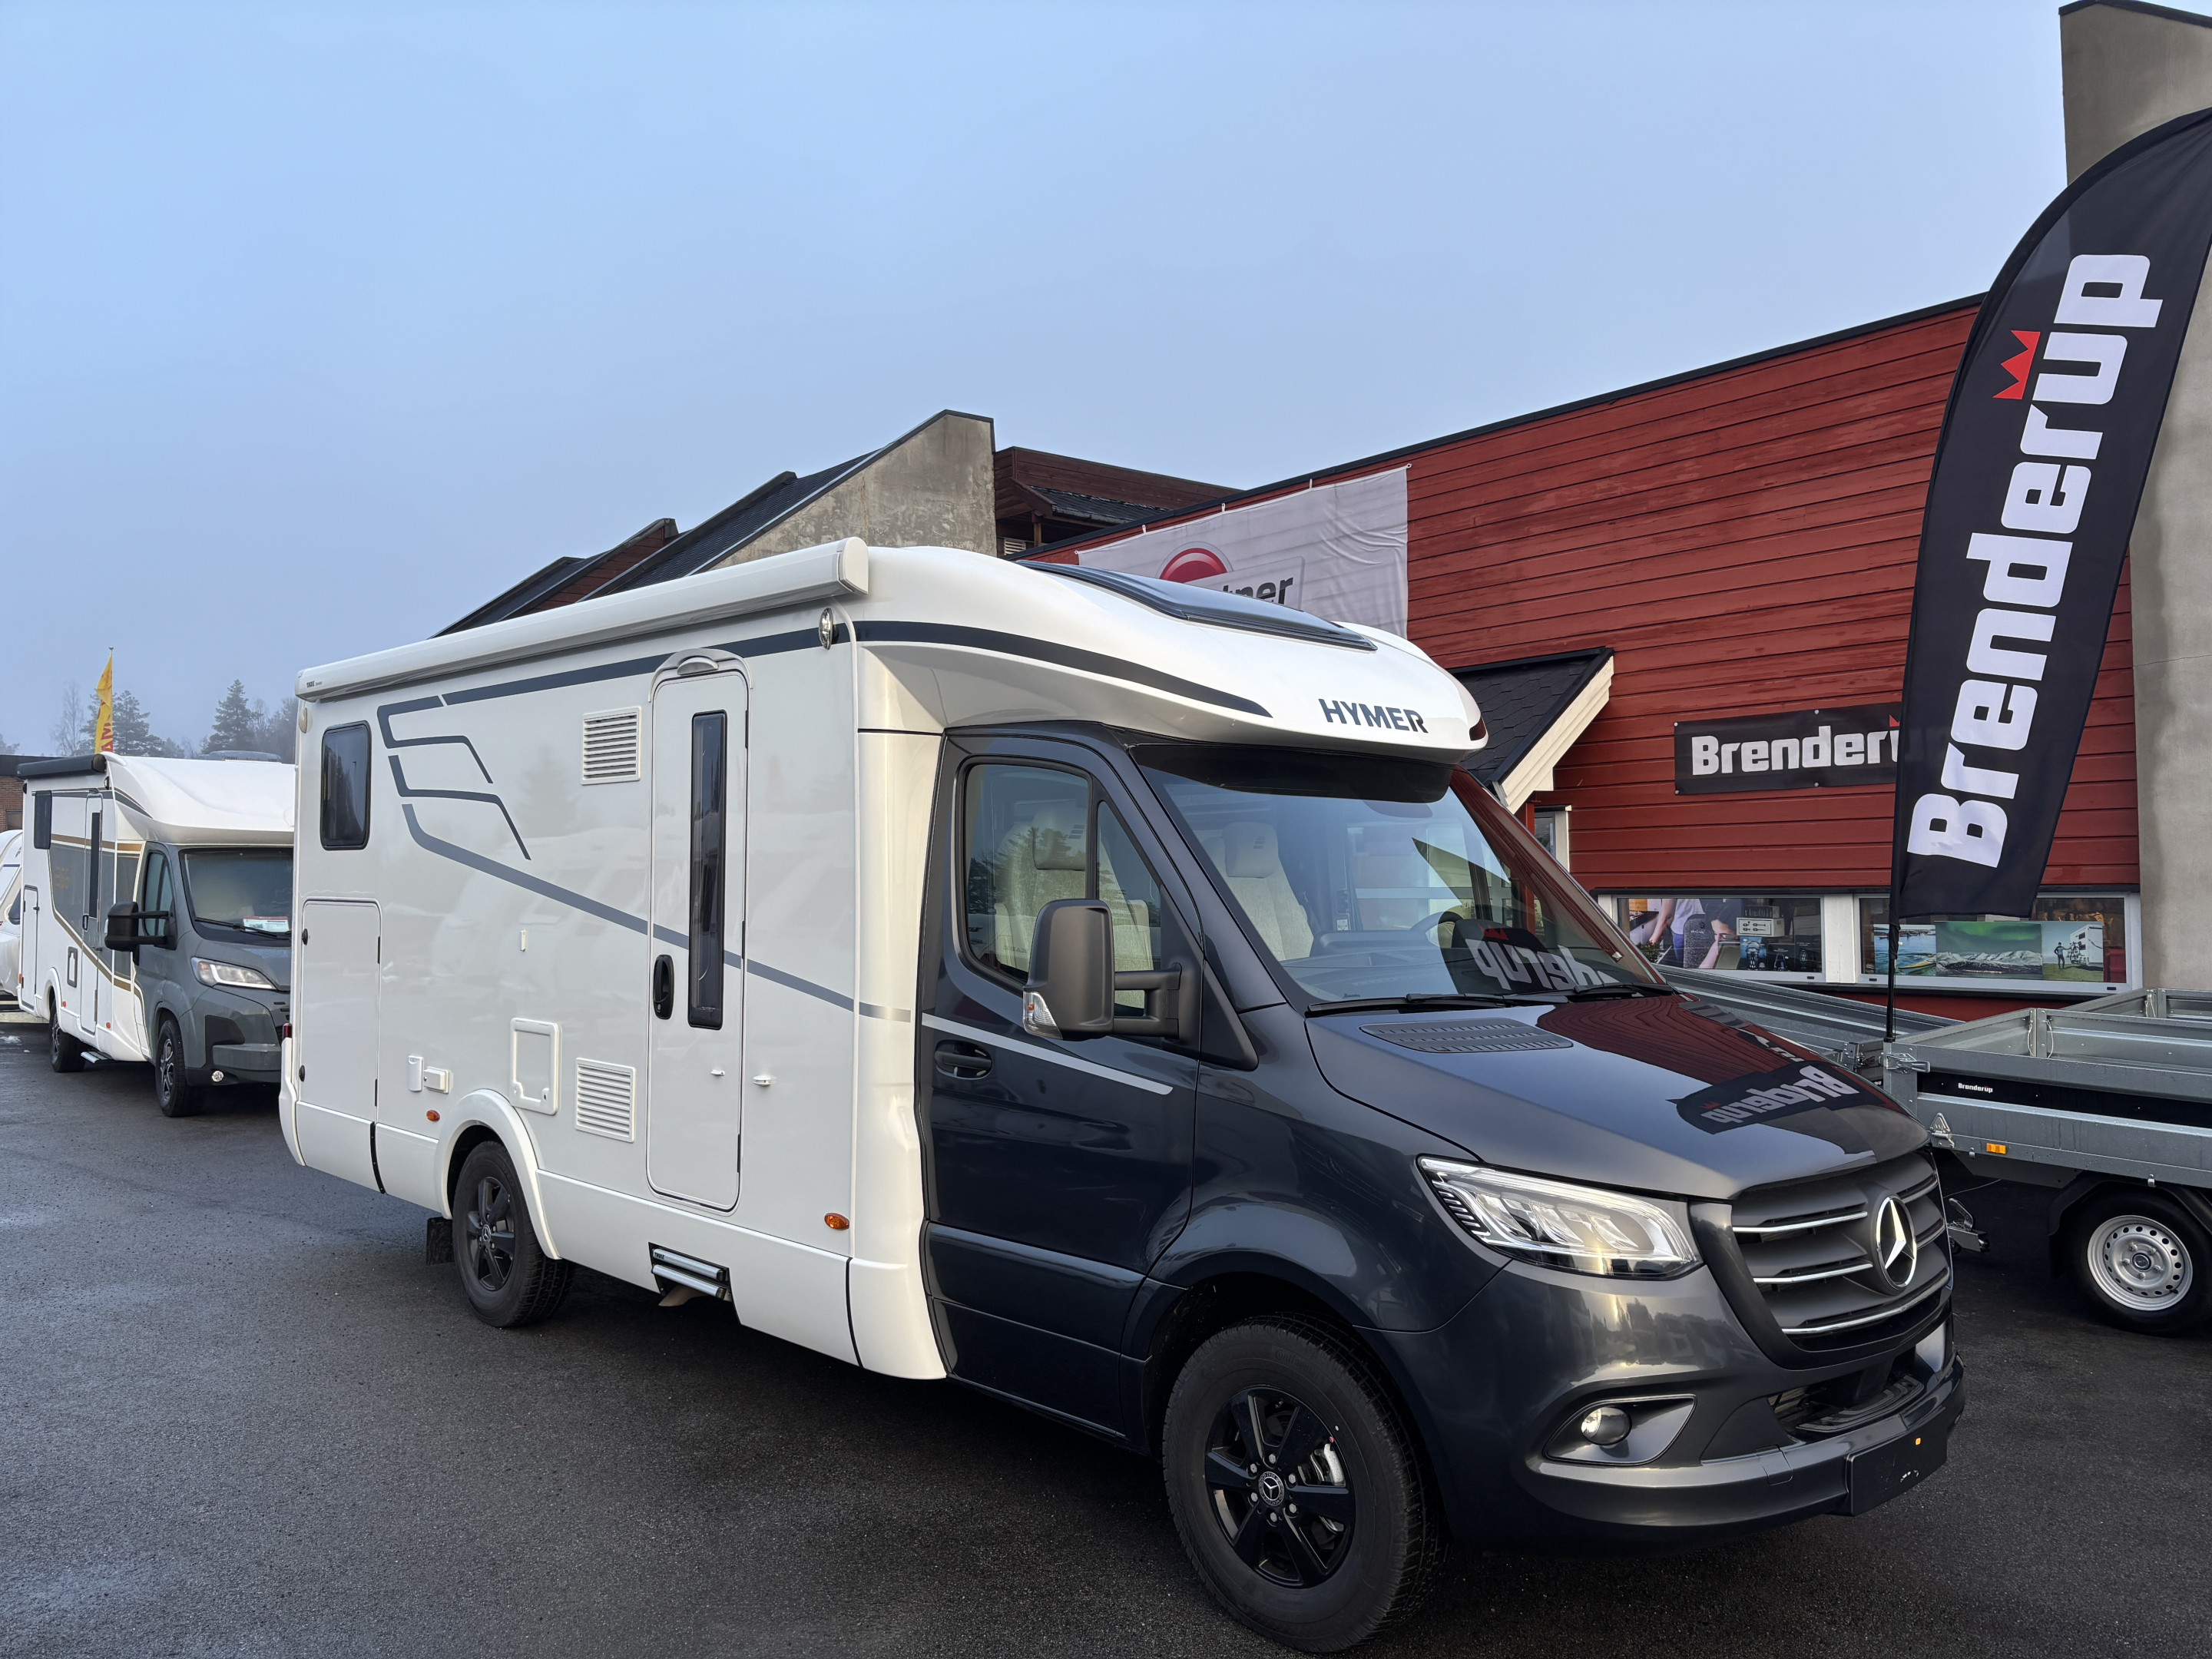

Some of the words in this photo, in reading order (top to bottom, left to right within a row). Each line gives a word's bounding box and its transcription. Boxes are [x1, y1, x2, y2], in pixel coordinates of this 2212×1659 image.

[1907, 254, 2164, 868] Brenderup
[1318, 698, 1429, 733] HYMER
[1692, 725, 1899, 776] Brender
[1958, 1082, 1993, 1094] Brenderup
